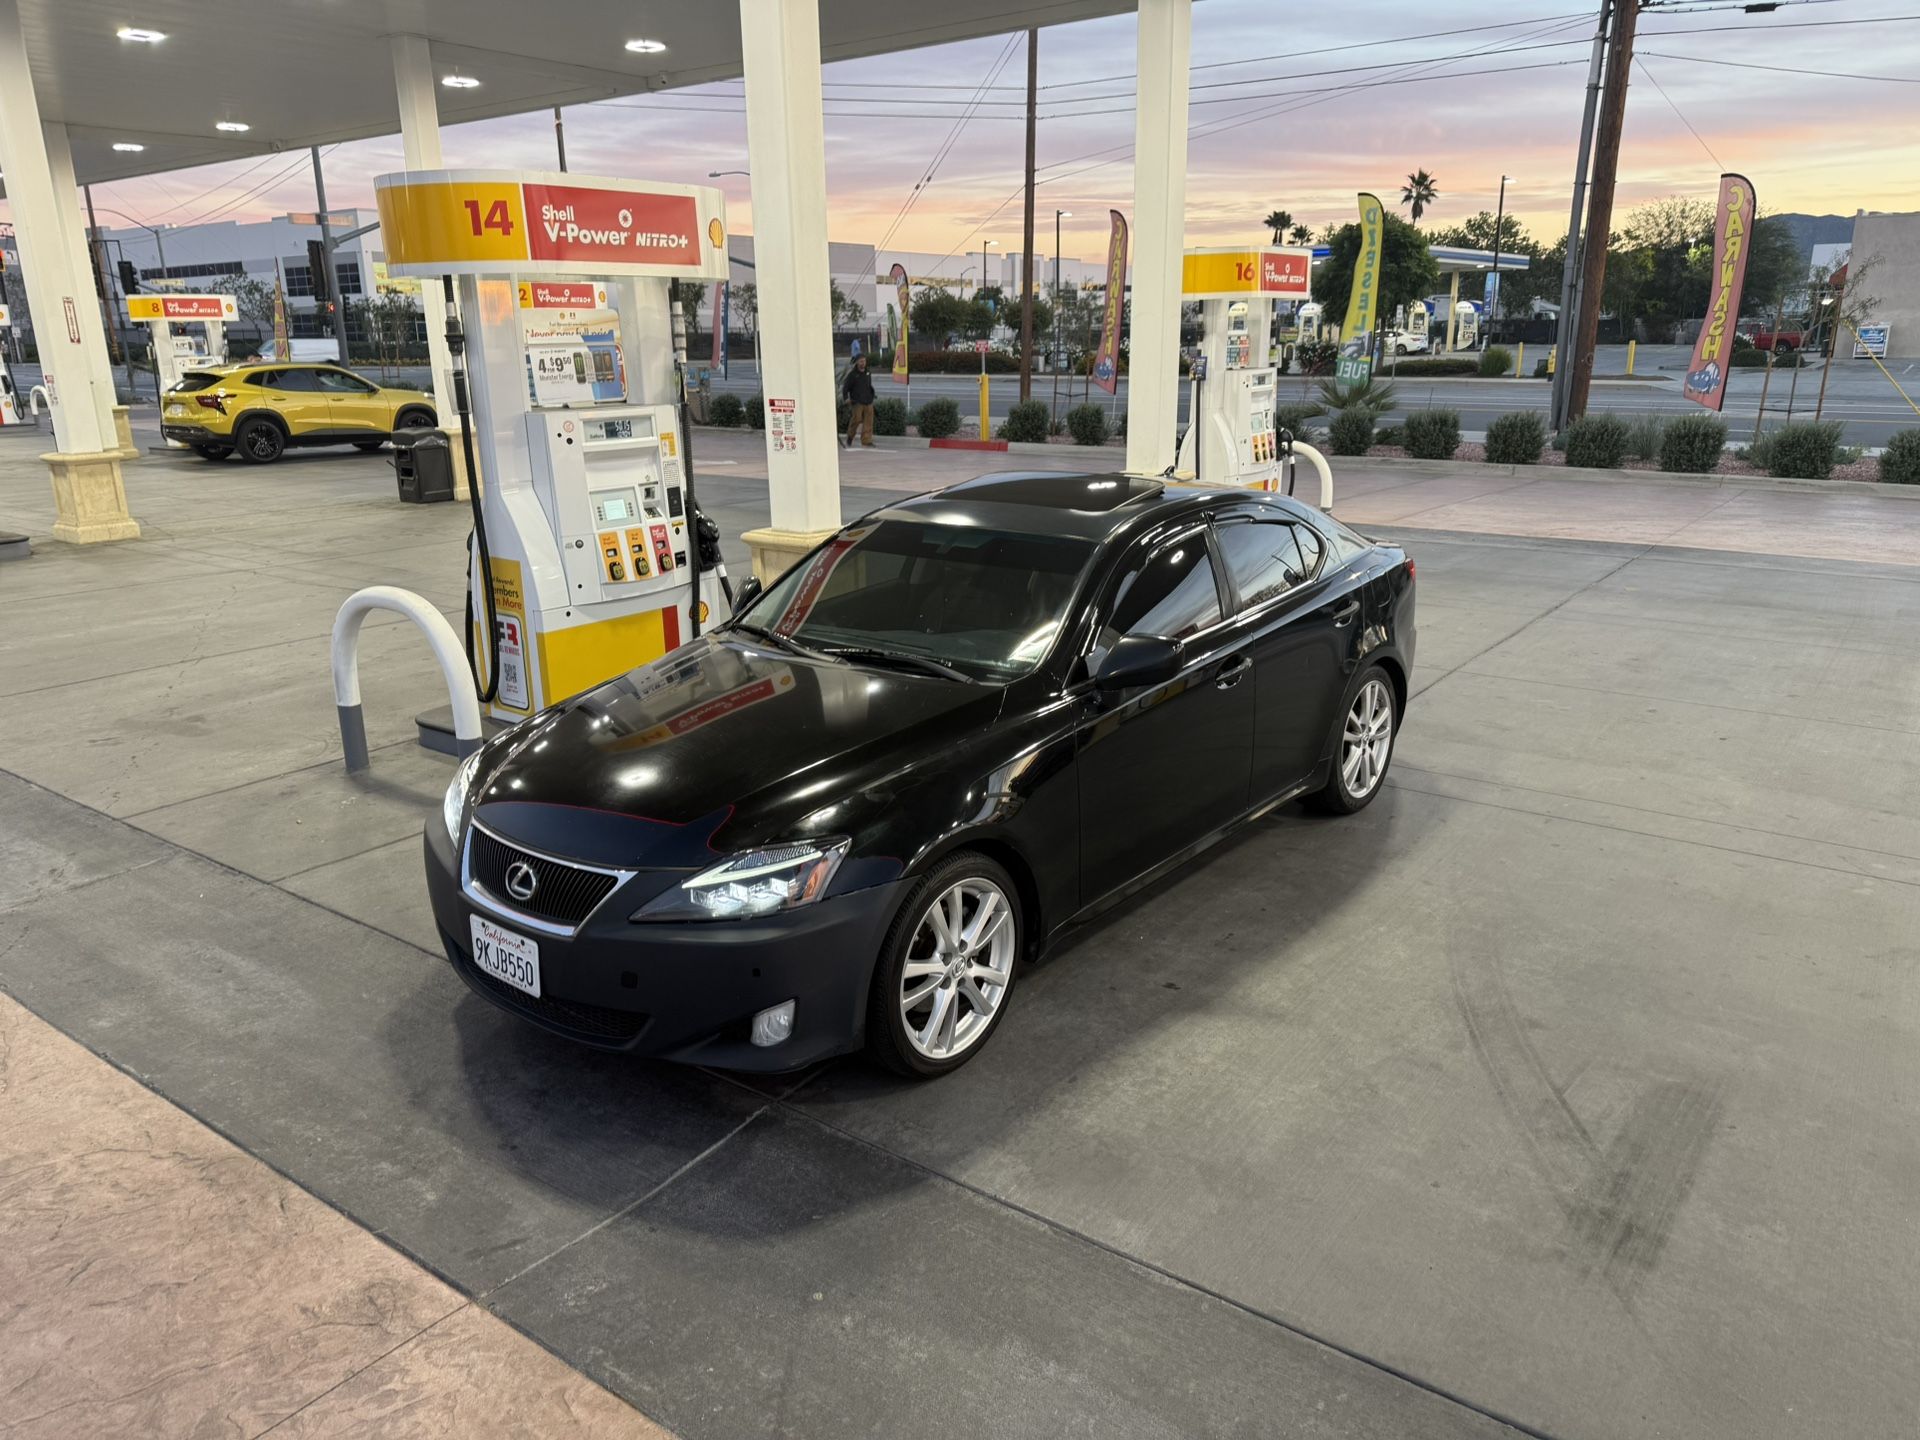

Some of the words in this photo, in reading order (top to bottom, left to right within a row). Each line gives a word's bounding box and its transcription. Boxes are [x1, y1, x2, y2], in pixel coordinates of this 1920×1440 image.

[463, 200, 514, 236] 14
[541, 204, 575, 222] Shell
[543, 221, 629, 246] V-Power
[1235, 262, 1256, 281] 16
[538, 293, 569, 303] V-Power
[151, 302, 160, 313] 8
[539, 358, 547, 373] 4
[503, 596, 521, 610] More
[483, 924, 522, 950] California
[475, 937, 534, 987] 9KJB550
